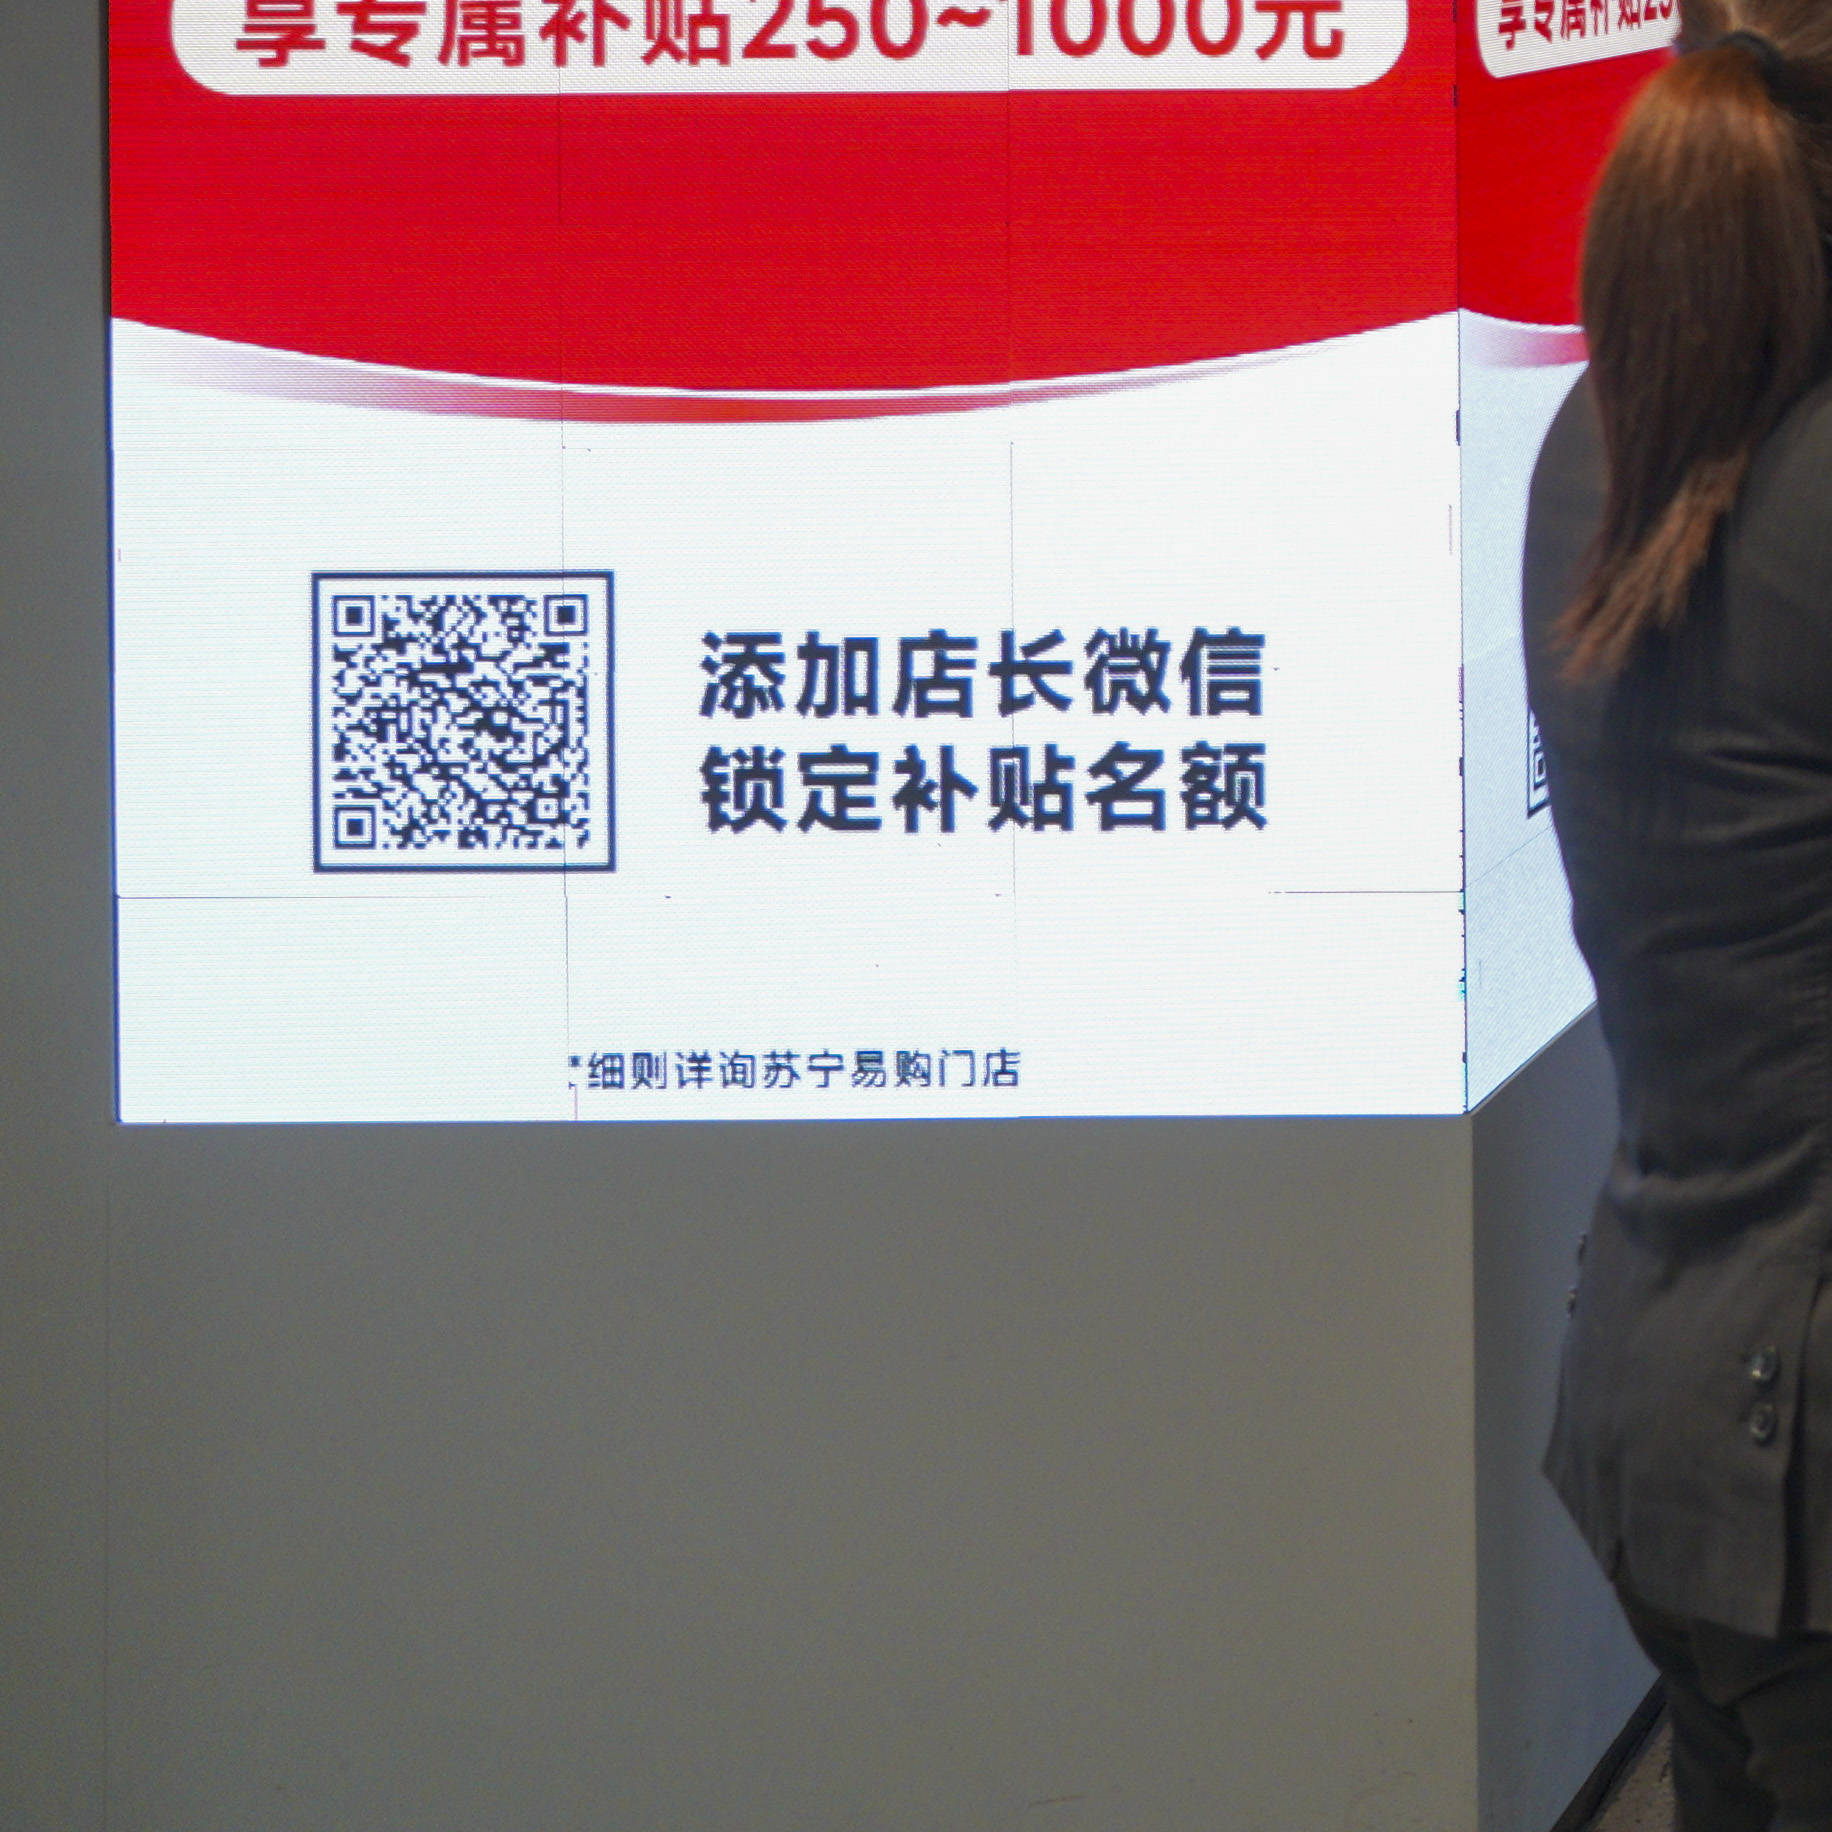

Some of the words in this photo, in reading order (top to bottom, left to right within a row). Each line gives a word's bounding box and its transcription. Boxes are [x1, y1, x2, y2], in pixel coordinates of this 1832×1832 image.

[699, 627, 1266, 720] 添加店长微信
[699, 741, 1268, 836] 锁定补贴名额
